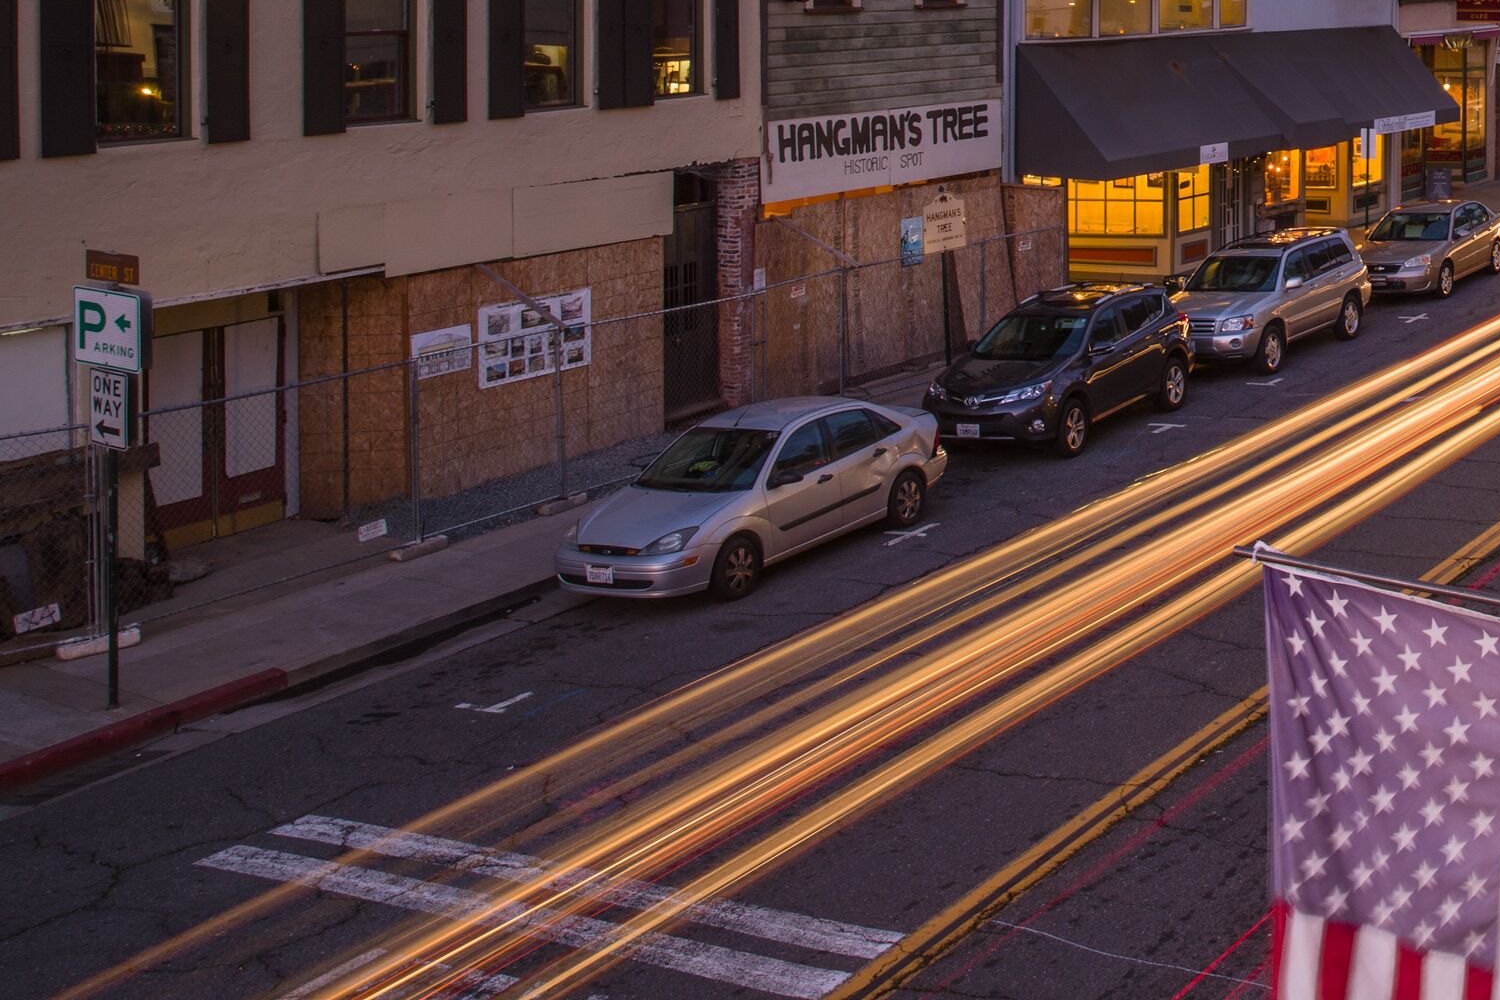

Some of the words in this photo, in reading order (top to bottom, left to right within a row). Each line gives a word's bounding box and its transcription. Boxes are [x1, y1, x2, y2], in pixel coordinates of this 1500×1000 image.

[777, 110, 923, 163] HANGMAN'S
[926, 104, 988, 145] TREE
[843, 156, 889, 176] HISTORIC
[900, 151, 924, 170] SPOT
[926, 208, 962, 222] HANGMAN'S
[937, 223, 953, 234] TREE
[90, 263, 119, 281] CENTER
[123, 268, 135, 283] ST
[94, 375, 122, 397] ONE
[93, 396, 122, 418] WAY
